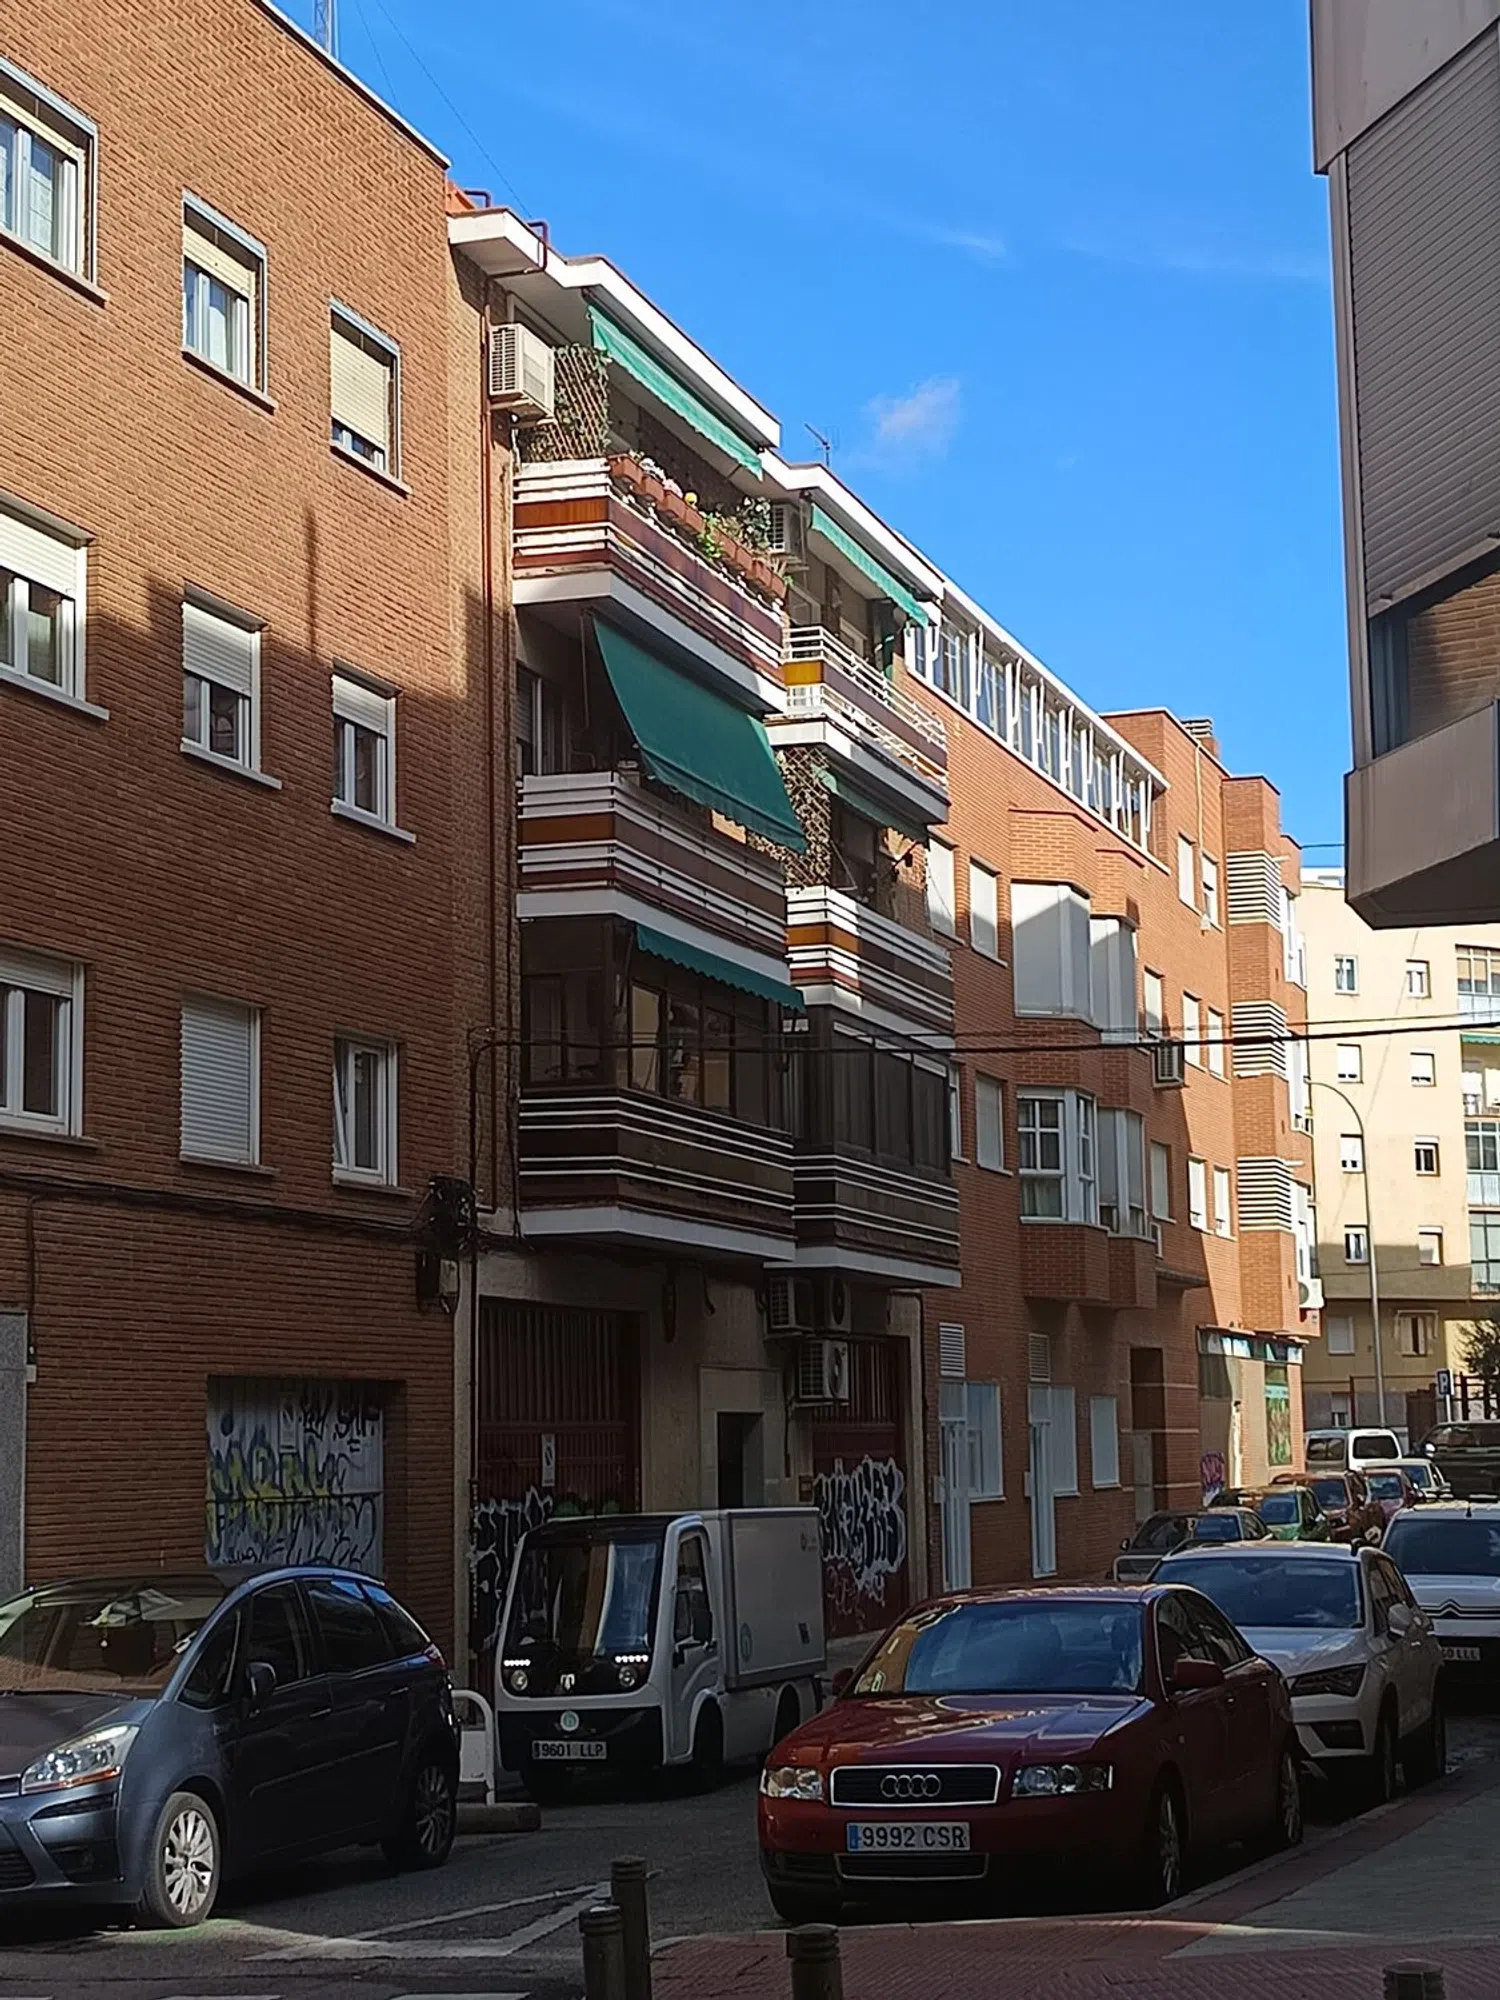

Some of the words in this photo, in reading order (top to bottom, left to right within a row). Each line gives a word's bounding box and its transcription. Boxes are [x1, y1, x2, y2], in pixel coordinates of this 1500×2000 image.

[542, 1743, 571, 1757] 9601
[580, 1743, 603, 1757] LLP
[862, 1826, 916, 1848] 9992
[923, 1826, 965, 1848] CSR
